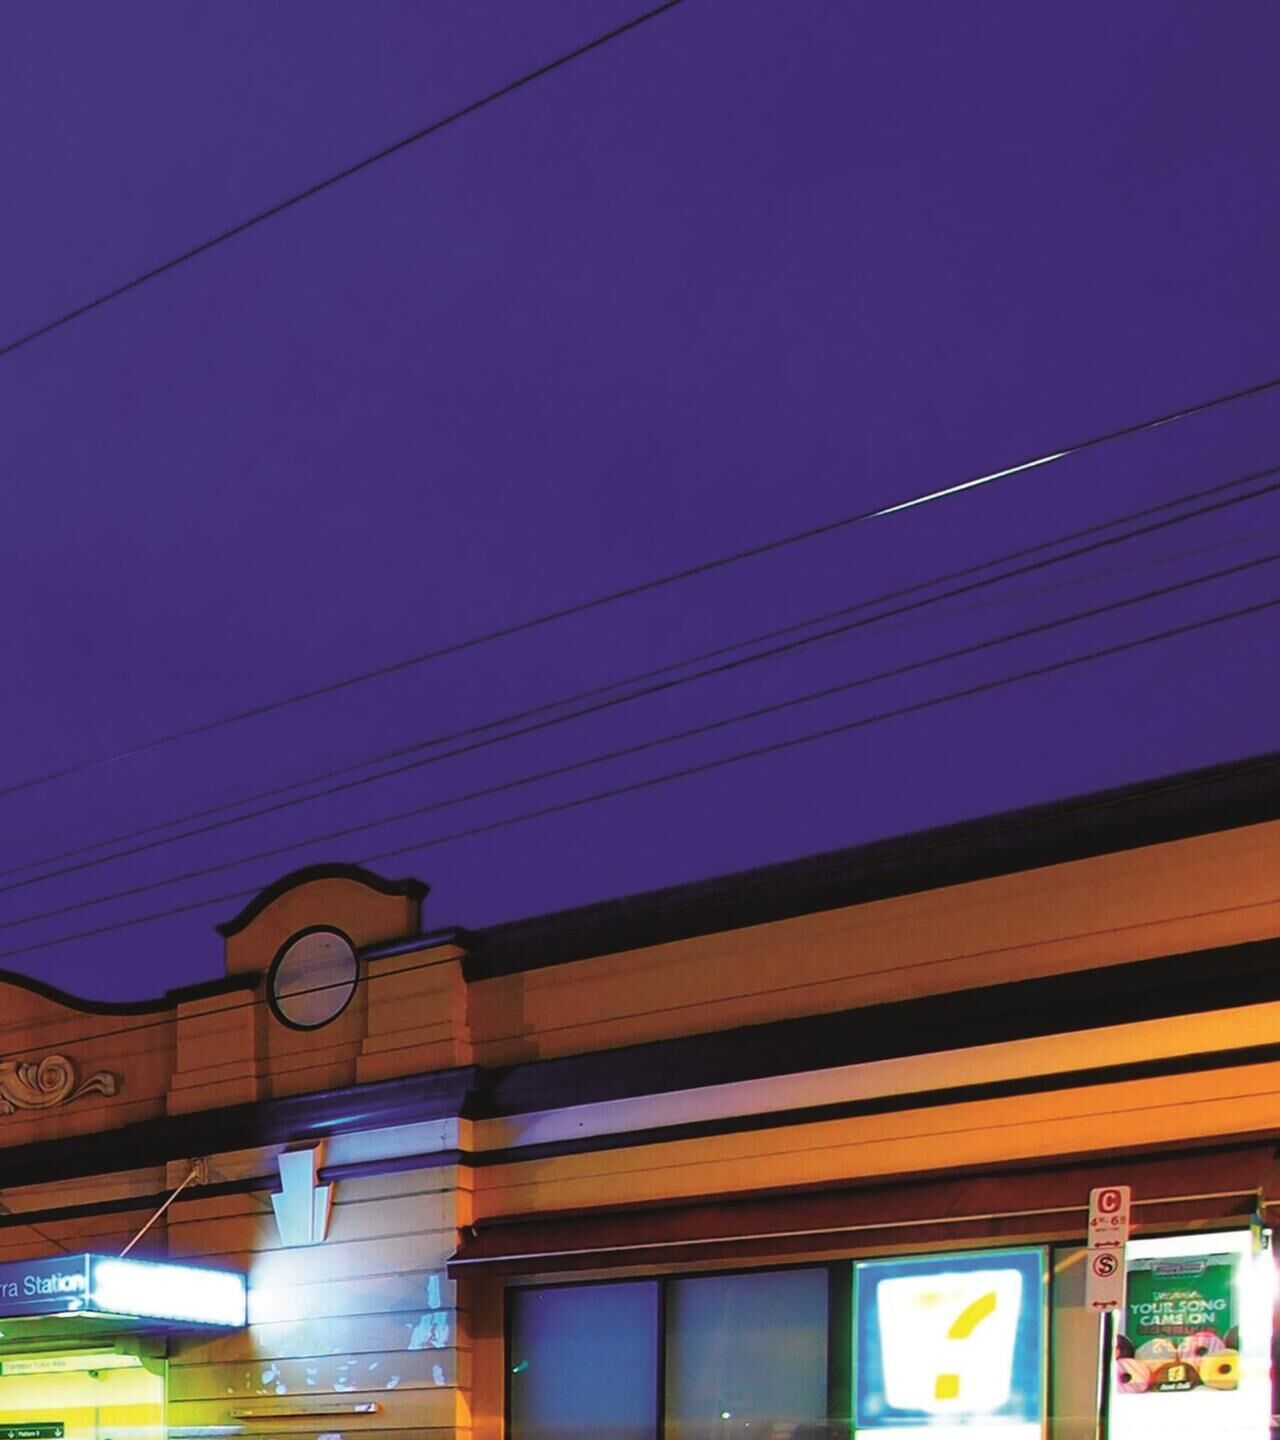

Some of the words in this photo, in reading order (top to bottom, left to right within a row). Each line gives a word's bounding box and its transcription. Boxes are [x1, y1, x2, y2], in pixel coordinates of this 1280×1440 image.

[23, 1272, 85, 1296] Station
[1131, 1302, 1174, 1314] YOUR
[1178, 1299, 1226, 1313] SONG
[1140, 1313, 1184, 1326] CAME
[1188, 1312, 1216, 1324] ON
